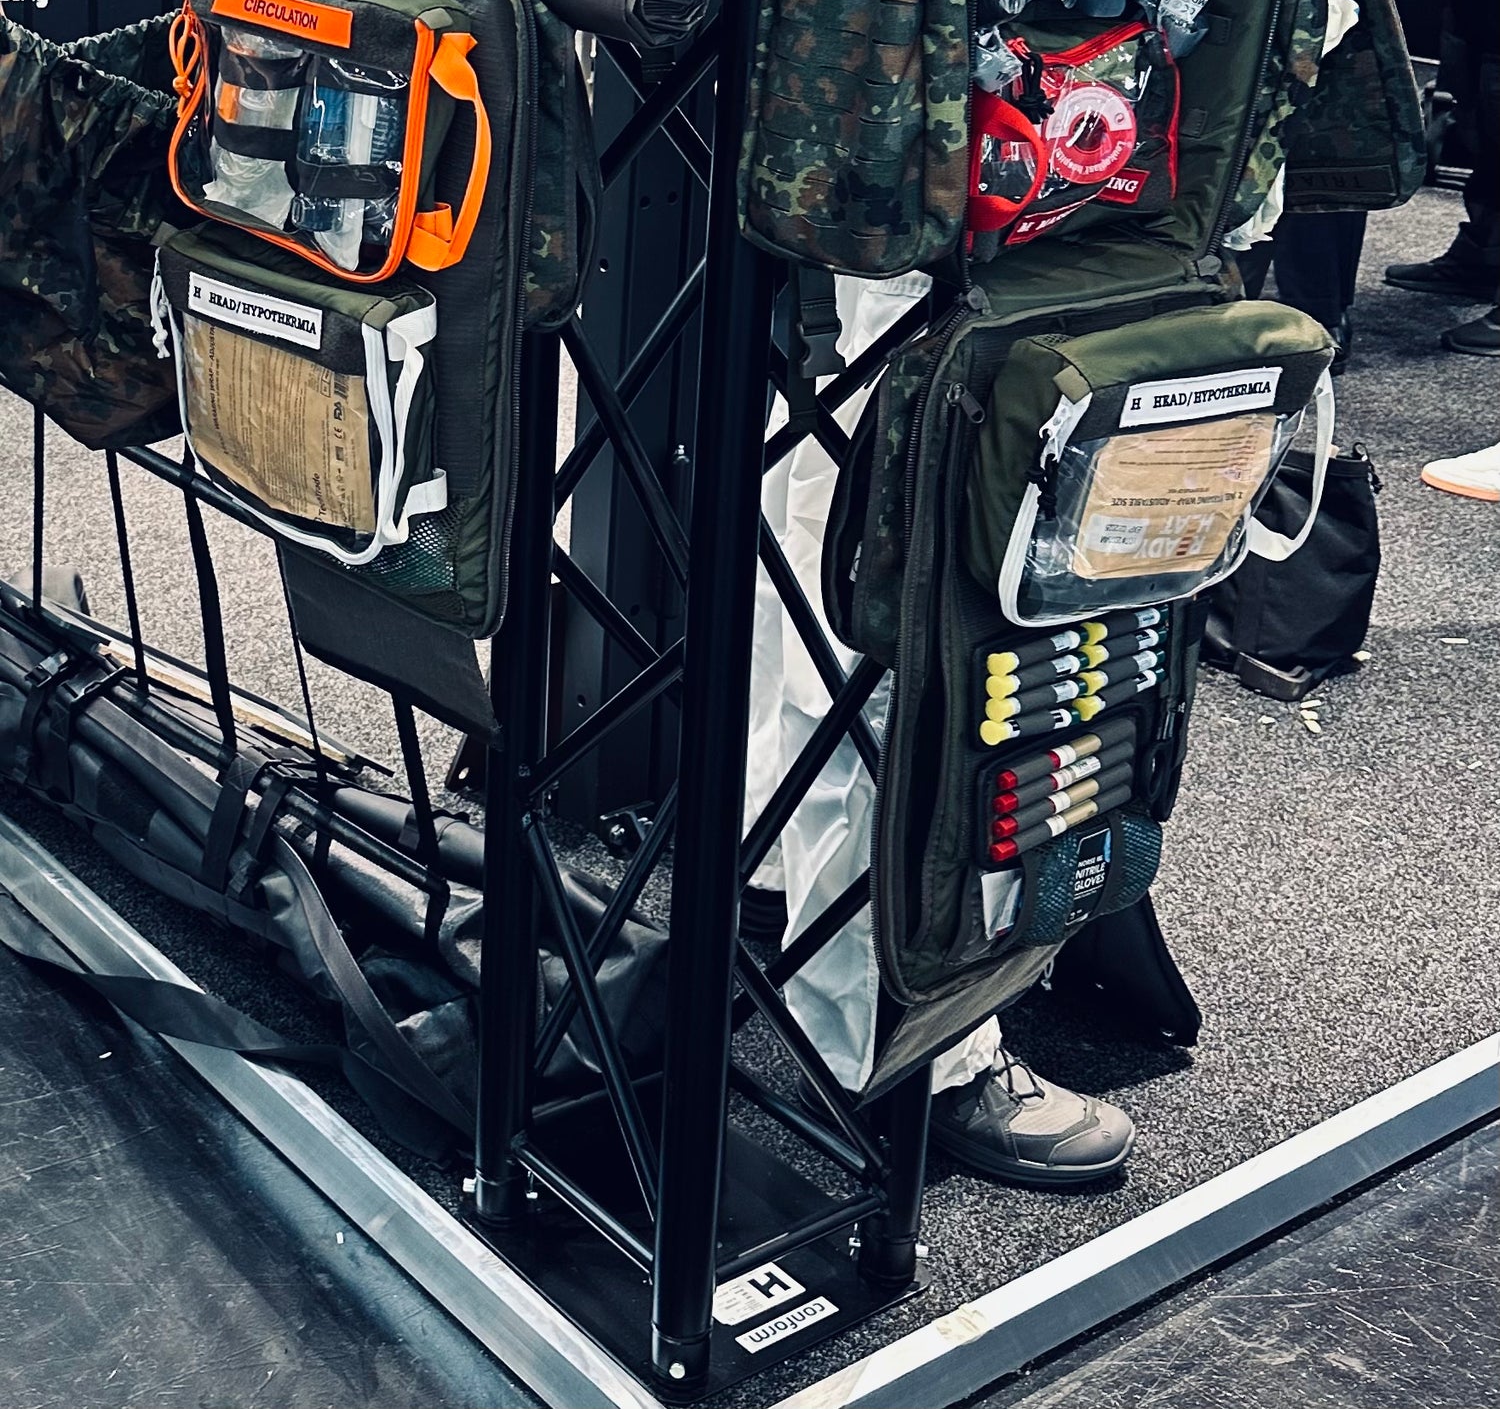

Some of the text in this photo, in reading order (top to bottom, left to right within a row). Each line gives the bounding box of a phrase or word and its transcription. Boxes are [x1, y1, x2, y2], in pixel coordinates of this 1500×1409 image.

[193, 285, 202, 299] H
[1130, 397, 1142, 411] H
[1075, 862, 1106, 879] NITRILE
[1074, 872, 1105, 891] GLOVES
[748, 1302, 825, 1344] conform
